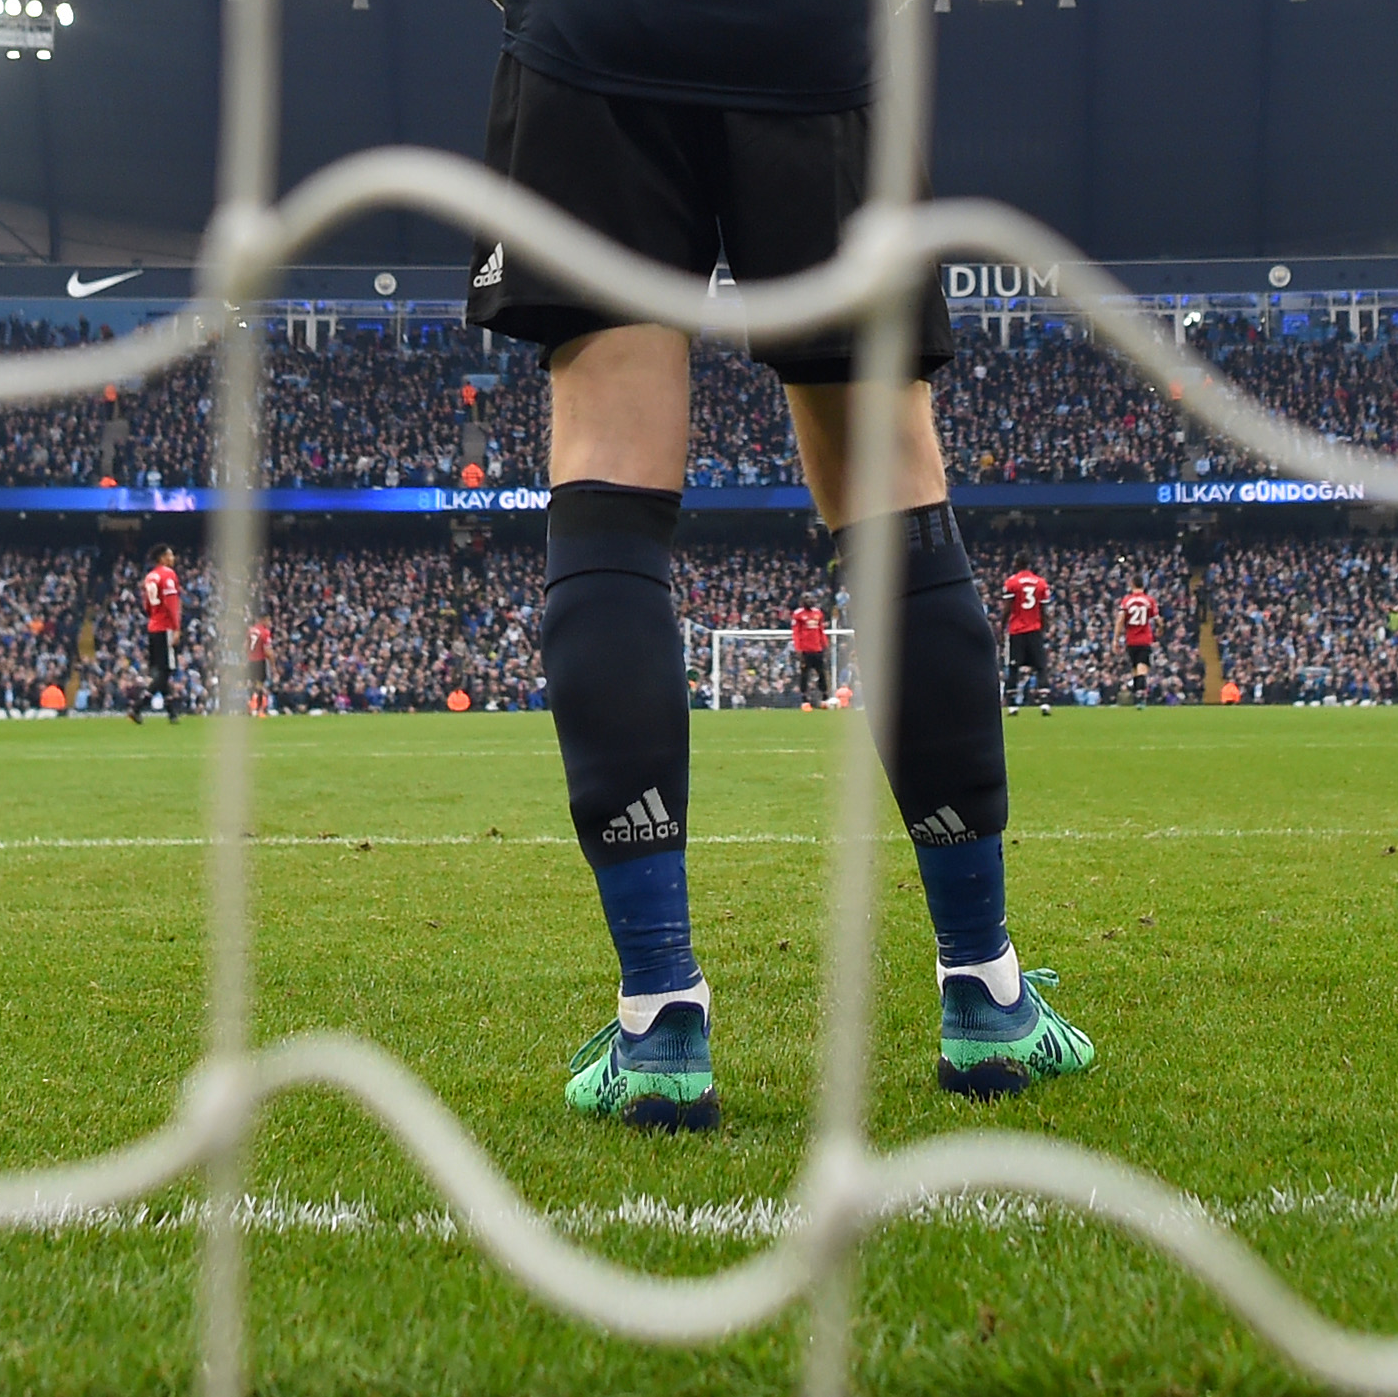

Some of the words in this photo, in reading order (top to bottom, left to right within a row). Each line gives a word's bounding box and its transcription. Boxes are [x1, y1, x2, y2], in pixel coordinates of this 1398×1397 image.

[942, 264, 1060, 298] DIUM
[1175, 482, 1235, 503] İLKAY
[1239, 480, 1364, 503] GÜNDOĞAN
[1021, 586, 1037, 610] 3
[1128, 604, 1148, 626] 21
[602, 820, 679, 843] adidas
